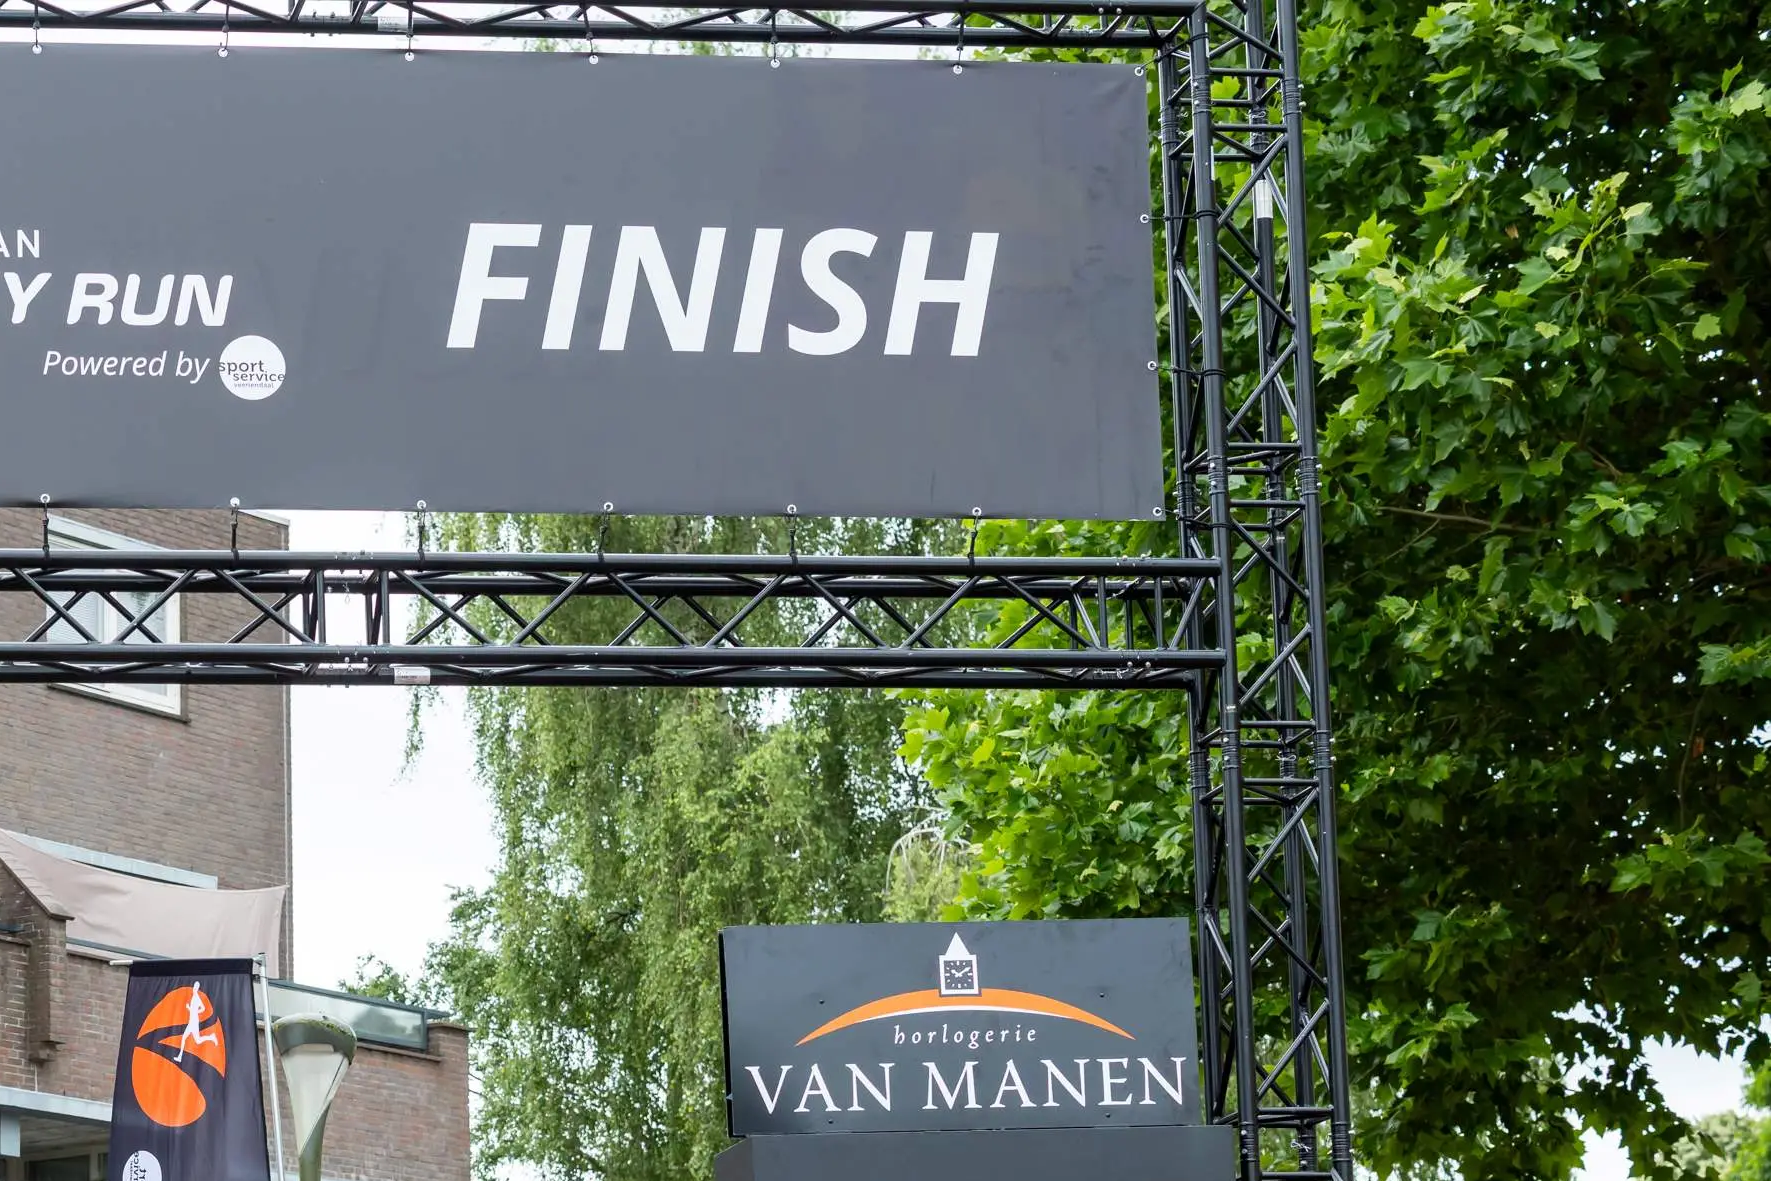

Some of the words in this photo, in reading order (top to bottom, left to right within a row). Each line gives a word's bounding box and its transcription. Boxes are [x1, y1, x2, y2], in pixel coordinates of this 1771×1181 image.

[66, 273, 233, 327] RUN
[446, 222, 1000, 357] FINISH
[42, 350, 166, 378] Powered
[174, 350, 211, 384] by
[219, 360, 265, 375] sport
[233, 370, 286, 382] service
[894, 1023, 1038, 1049] horlogerie
[744, 1062, 896, 1115] VAN
[921, 1056, 1188, 1110] MANEN
